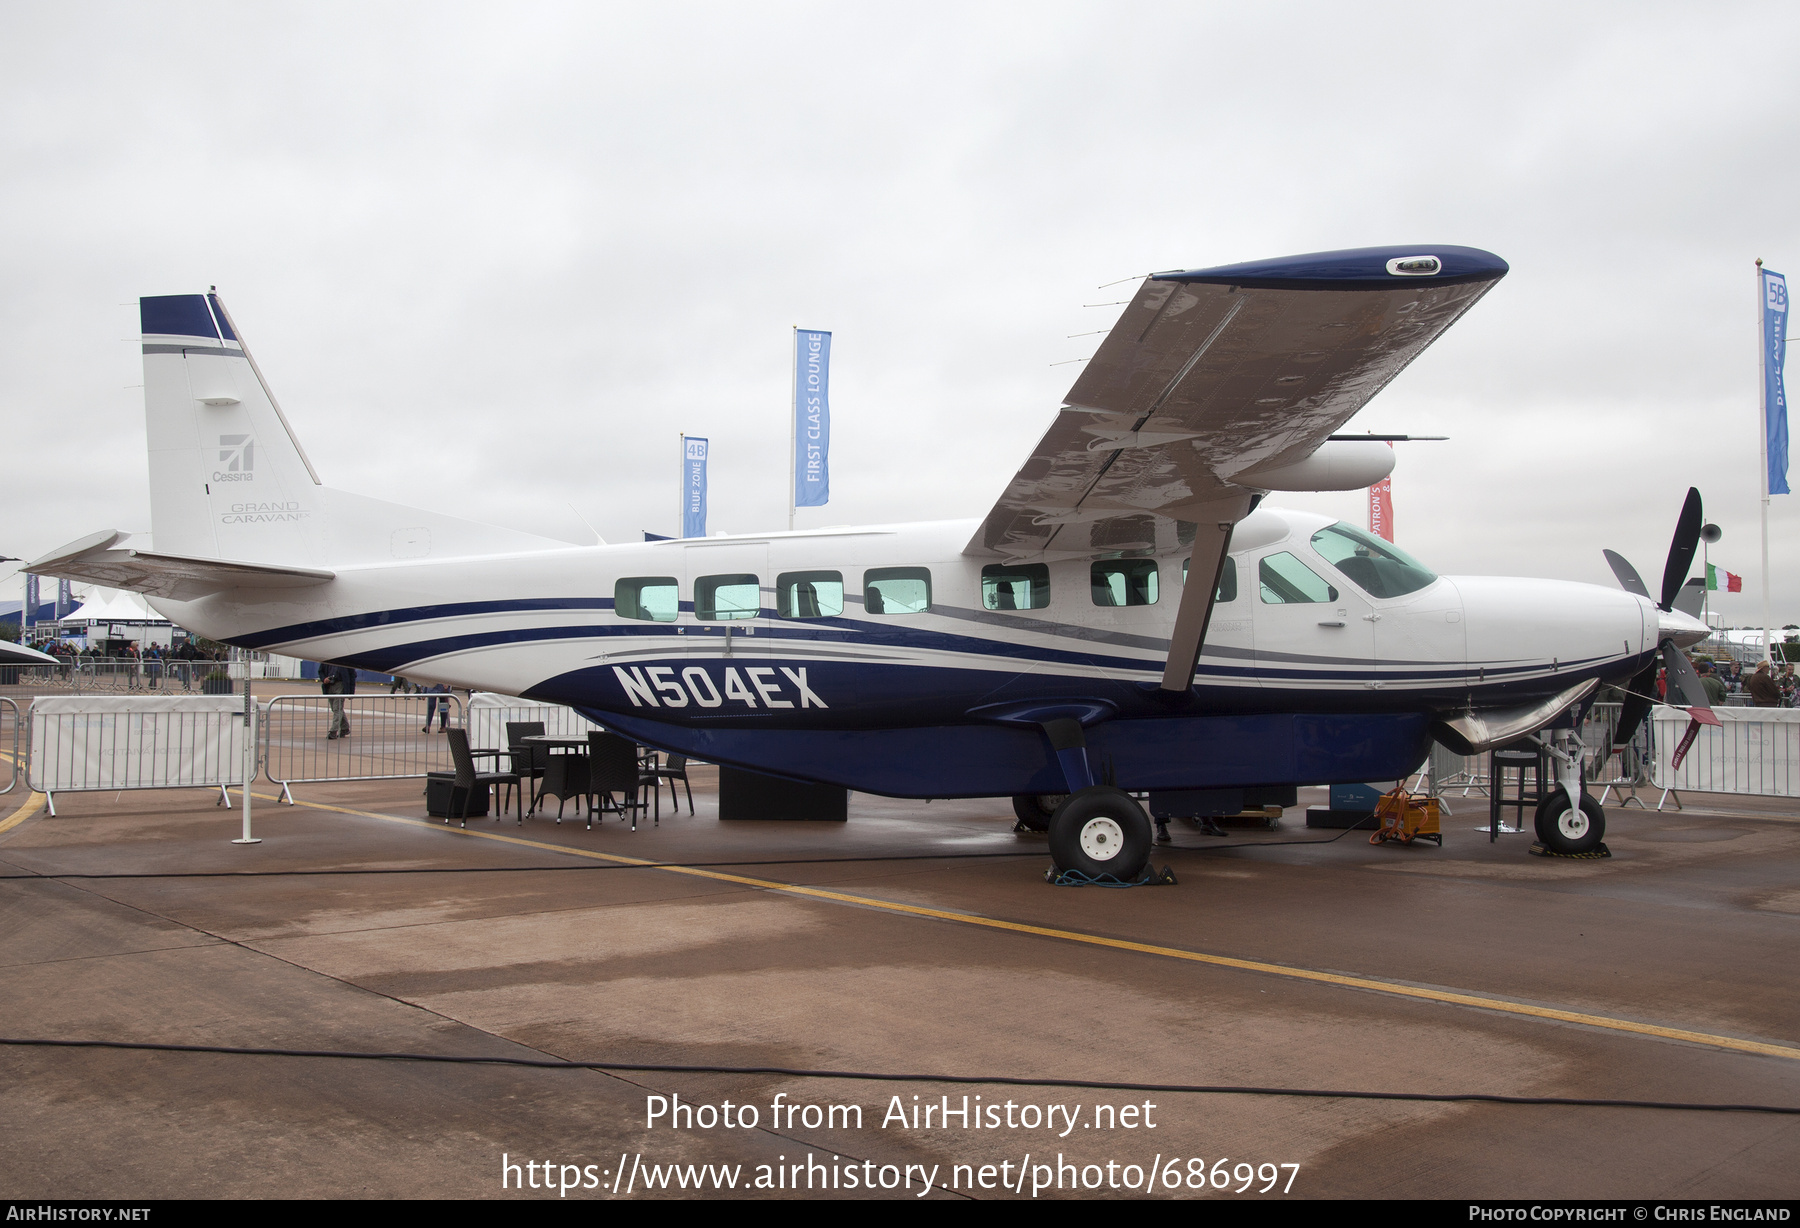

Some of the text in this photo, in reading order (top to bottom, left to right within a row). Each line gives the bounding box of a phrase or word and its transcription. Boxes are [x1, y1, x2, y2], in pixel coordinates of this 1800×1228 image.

[1769, 282, 1787, 305] 5B
[807, 333, 821, 482] FIRST CLASS LOUNGE
[688, 444, 705, 457] 4B
[212, 471, 253, 483] Cessna
[692, 461, 701, 513] BLUE ZONE
[231, 501, 299, 512] GRAND
[1371, 487, 1381, 538] PATRON'S
[611, 666, 829, 709] N504EX
